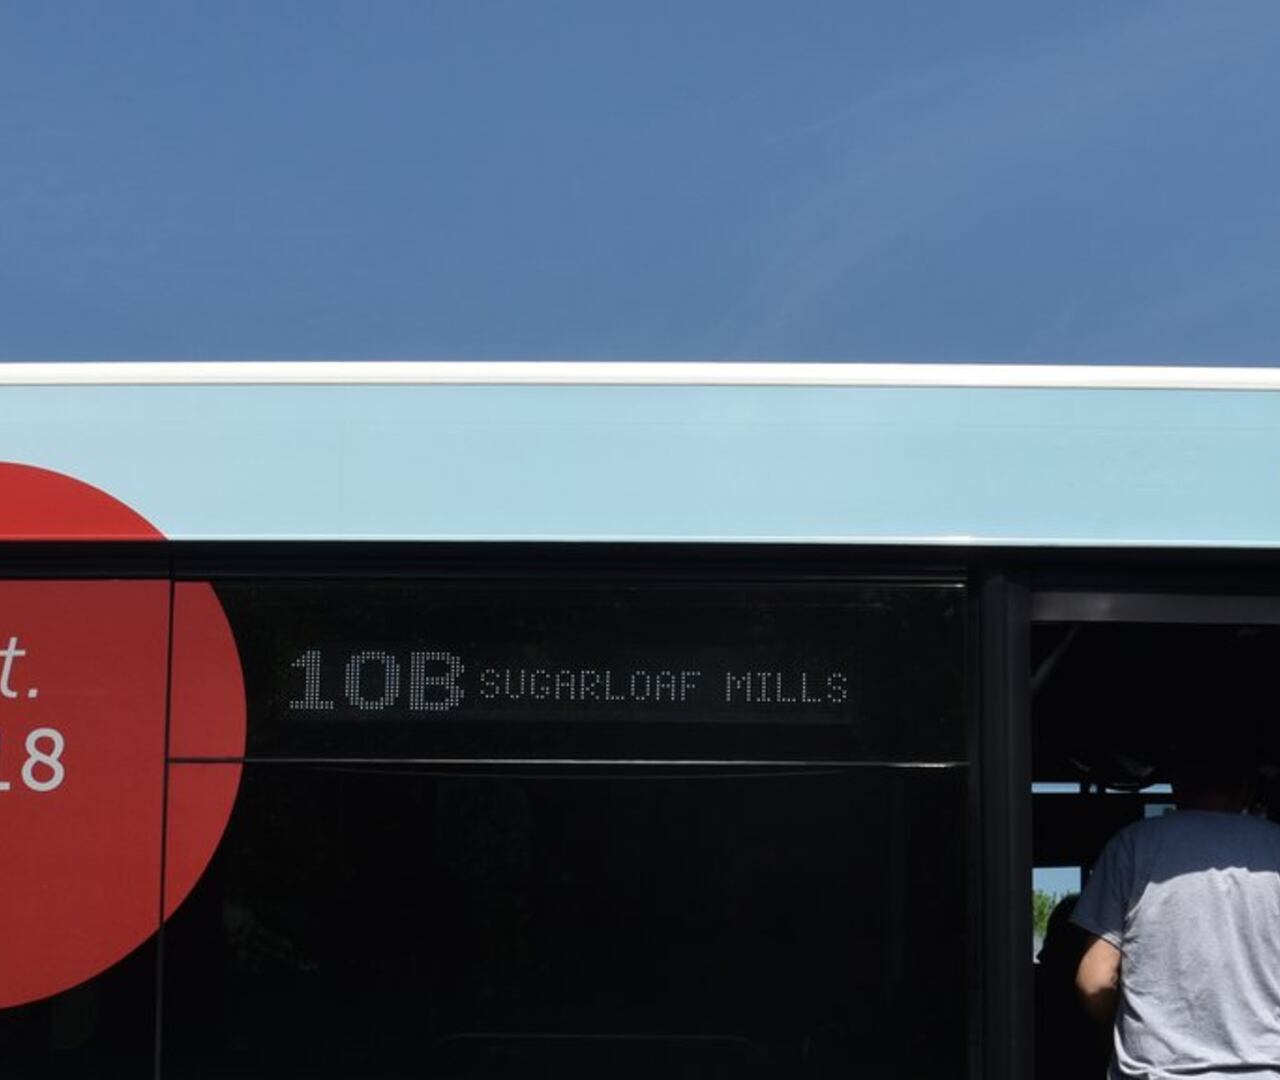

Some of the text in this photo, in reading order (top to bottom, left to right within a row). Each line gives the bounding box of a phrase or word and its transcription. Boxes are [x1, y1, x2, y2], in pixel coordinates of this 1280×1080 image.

[288, 649, 848, 711] 10B SUGARLOAF MILLS
